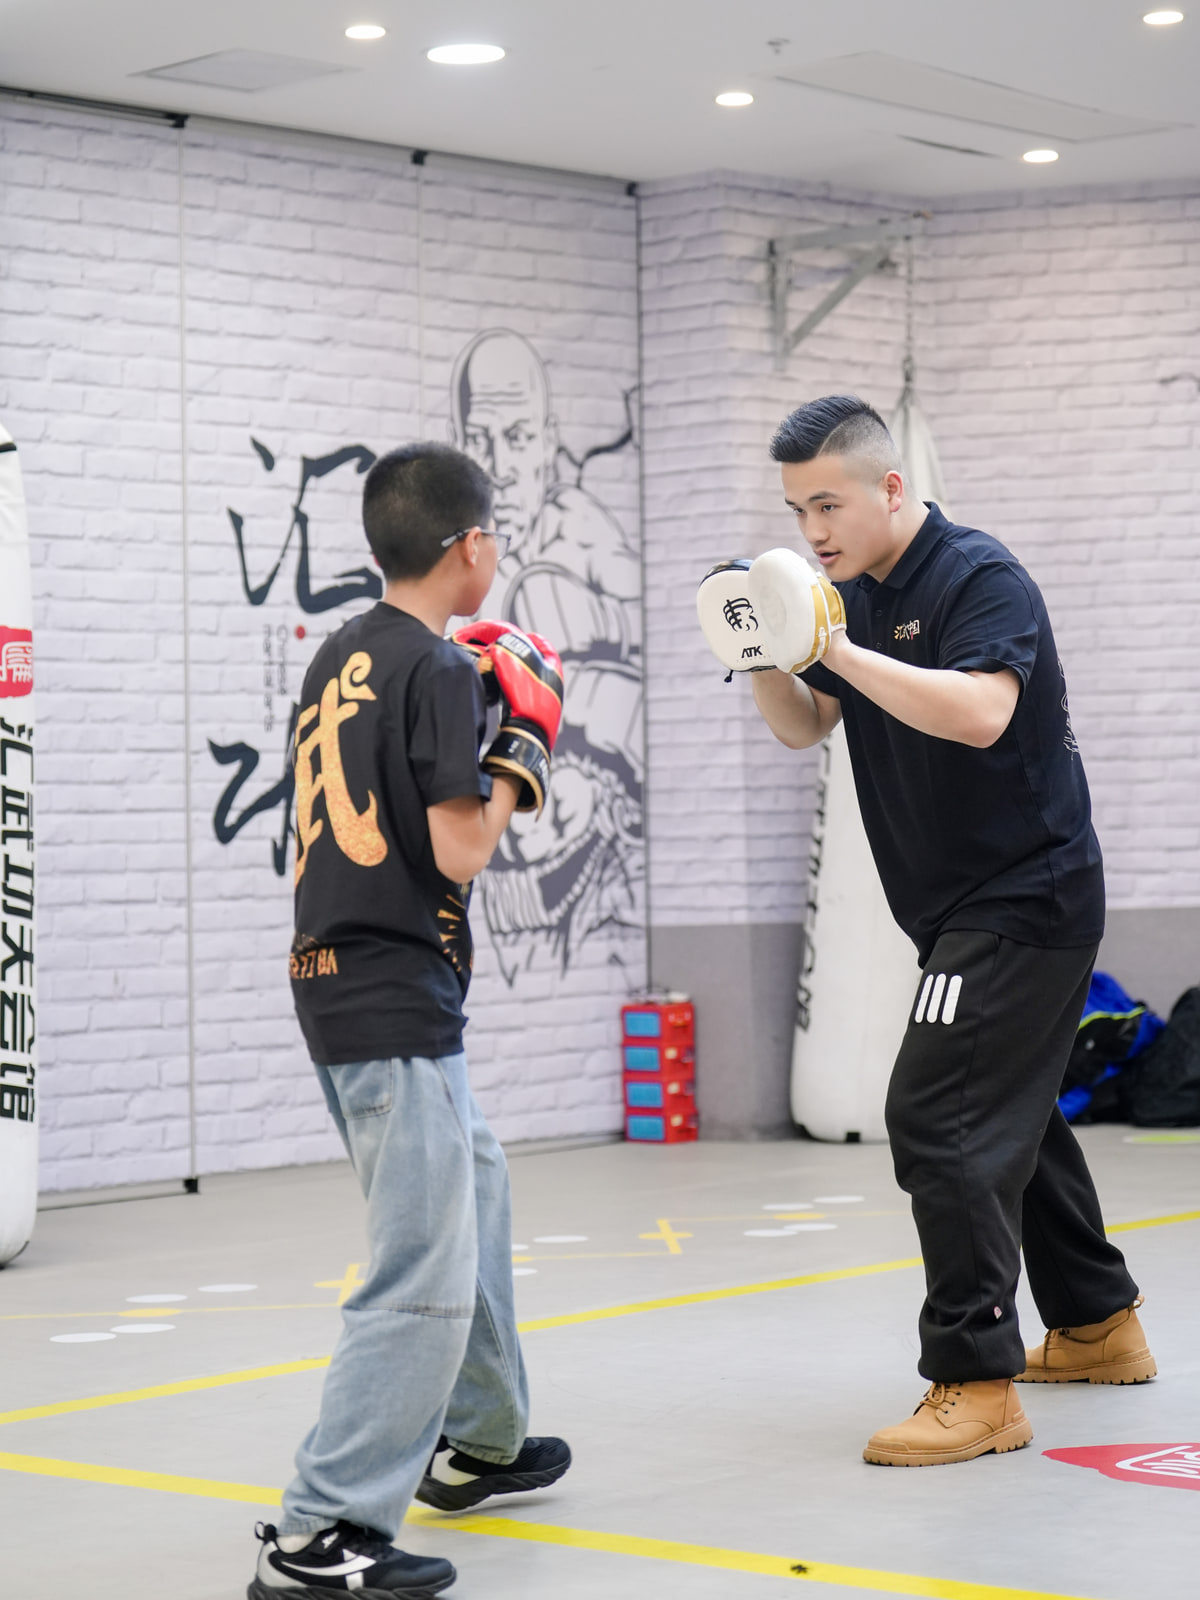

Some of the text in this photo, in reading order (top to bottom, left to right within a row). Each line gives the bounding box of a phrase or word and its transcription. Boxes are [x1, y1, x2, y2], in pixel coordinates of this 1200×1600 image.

[741, 646, 763, 659] ATK
[0, 717, 35, 1123] 汇武功夫会馆
